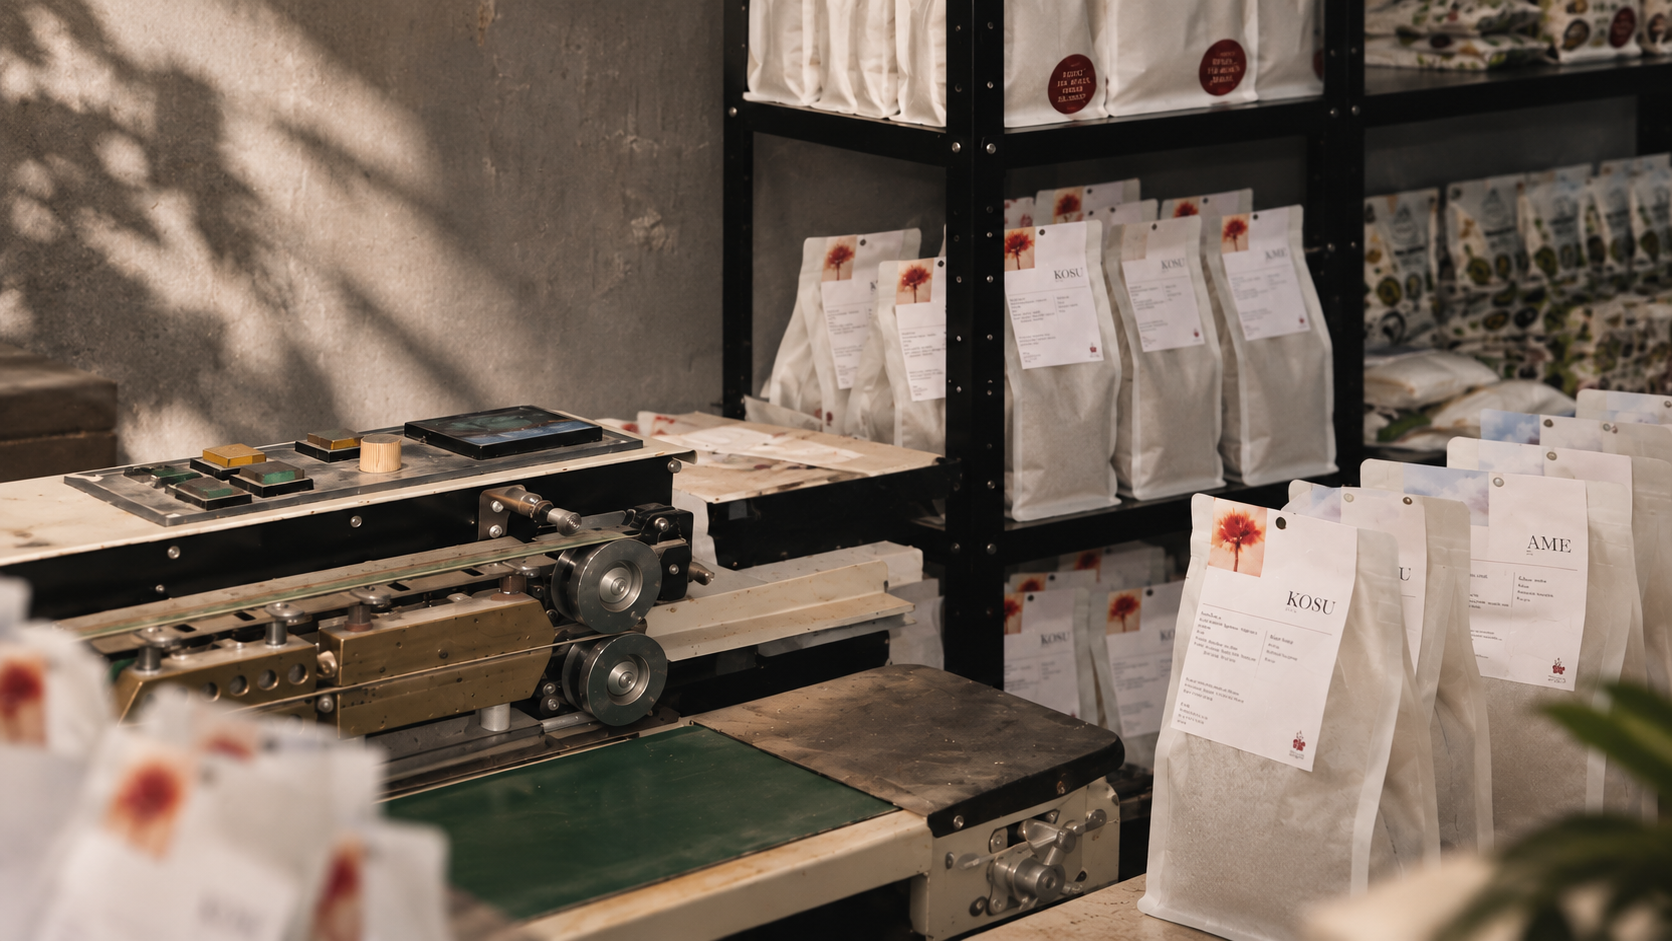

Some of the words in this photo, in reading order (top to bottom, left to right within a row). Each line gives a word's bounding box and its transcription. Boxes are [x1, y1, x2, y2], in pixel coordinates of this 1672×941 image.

[1161, 258, 1185, 271] KOSU
[1054, 267, 1083, 280] KOSU
[1527, 535, 1572, 553] AME
[1286, 590, 1336, 615] KOSU
[1041, 633, 1070, 646] KOSU
[1160, 629, 1175, 642] KO
